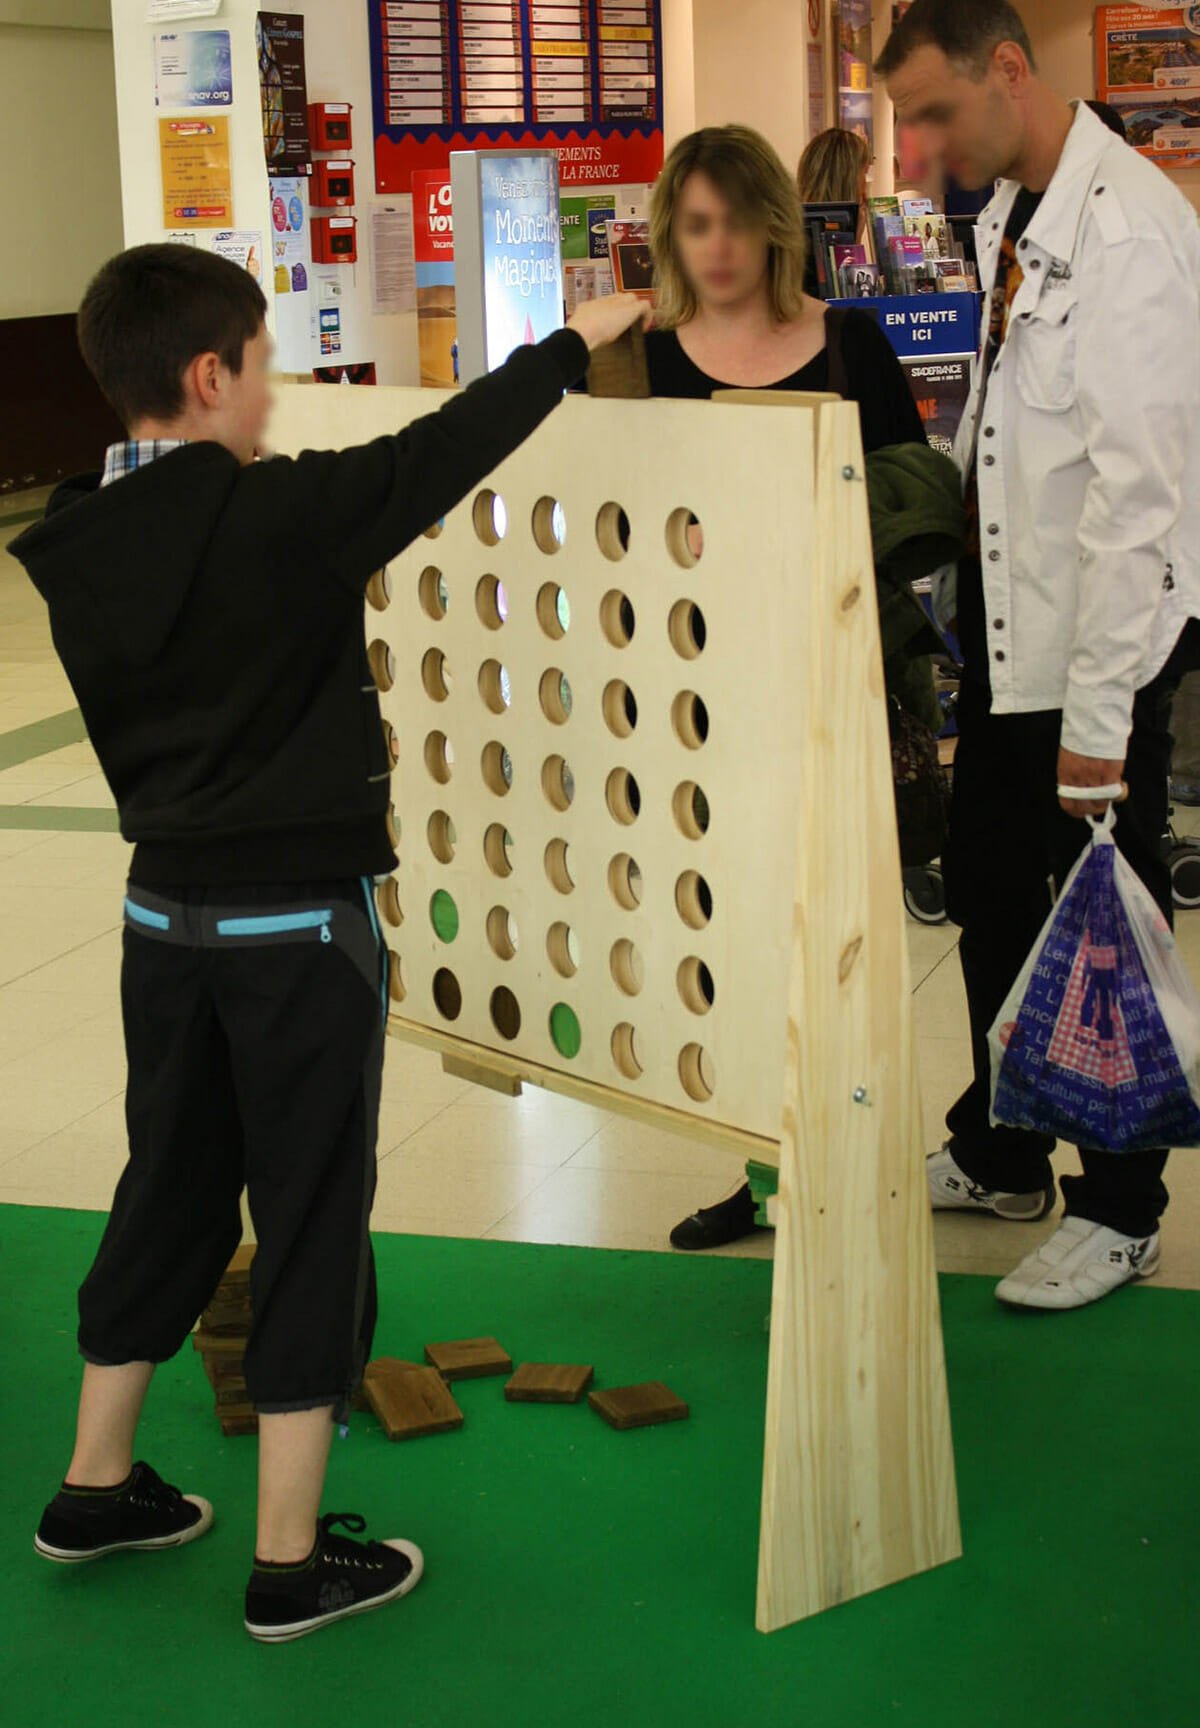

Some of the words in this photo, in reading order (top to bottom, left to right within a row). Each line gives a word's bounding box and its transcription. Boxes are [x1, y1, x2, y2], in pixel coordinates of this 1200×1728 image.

[556, 147, 601, 161] EMENTS
[563, 166, 577, 179] LA
[579, 164, 620, 178] FRANCE
[429, 184, 452, 214] LO
[429, 215, 453, 232] VOY
[560, 215, 580, 225] ENTE
[886, 313, 906, 325] EN
[910, 310, 957, 323] VENTE
[912, 329, 932, 341] ICI
[1038, 1078, 1085, 1105] culture
